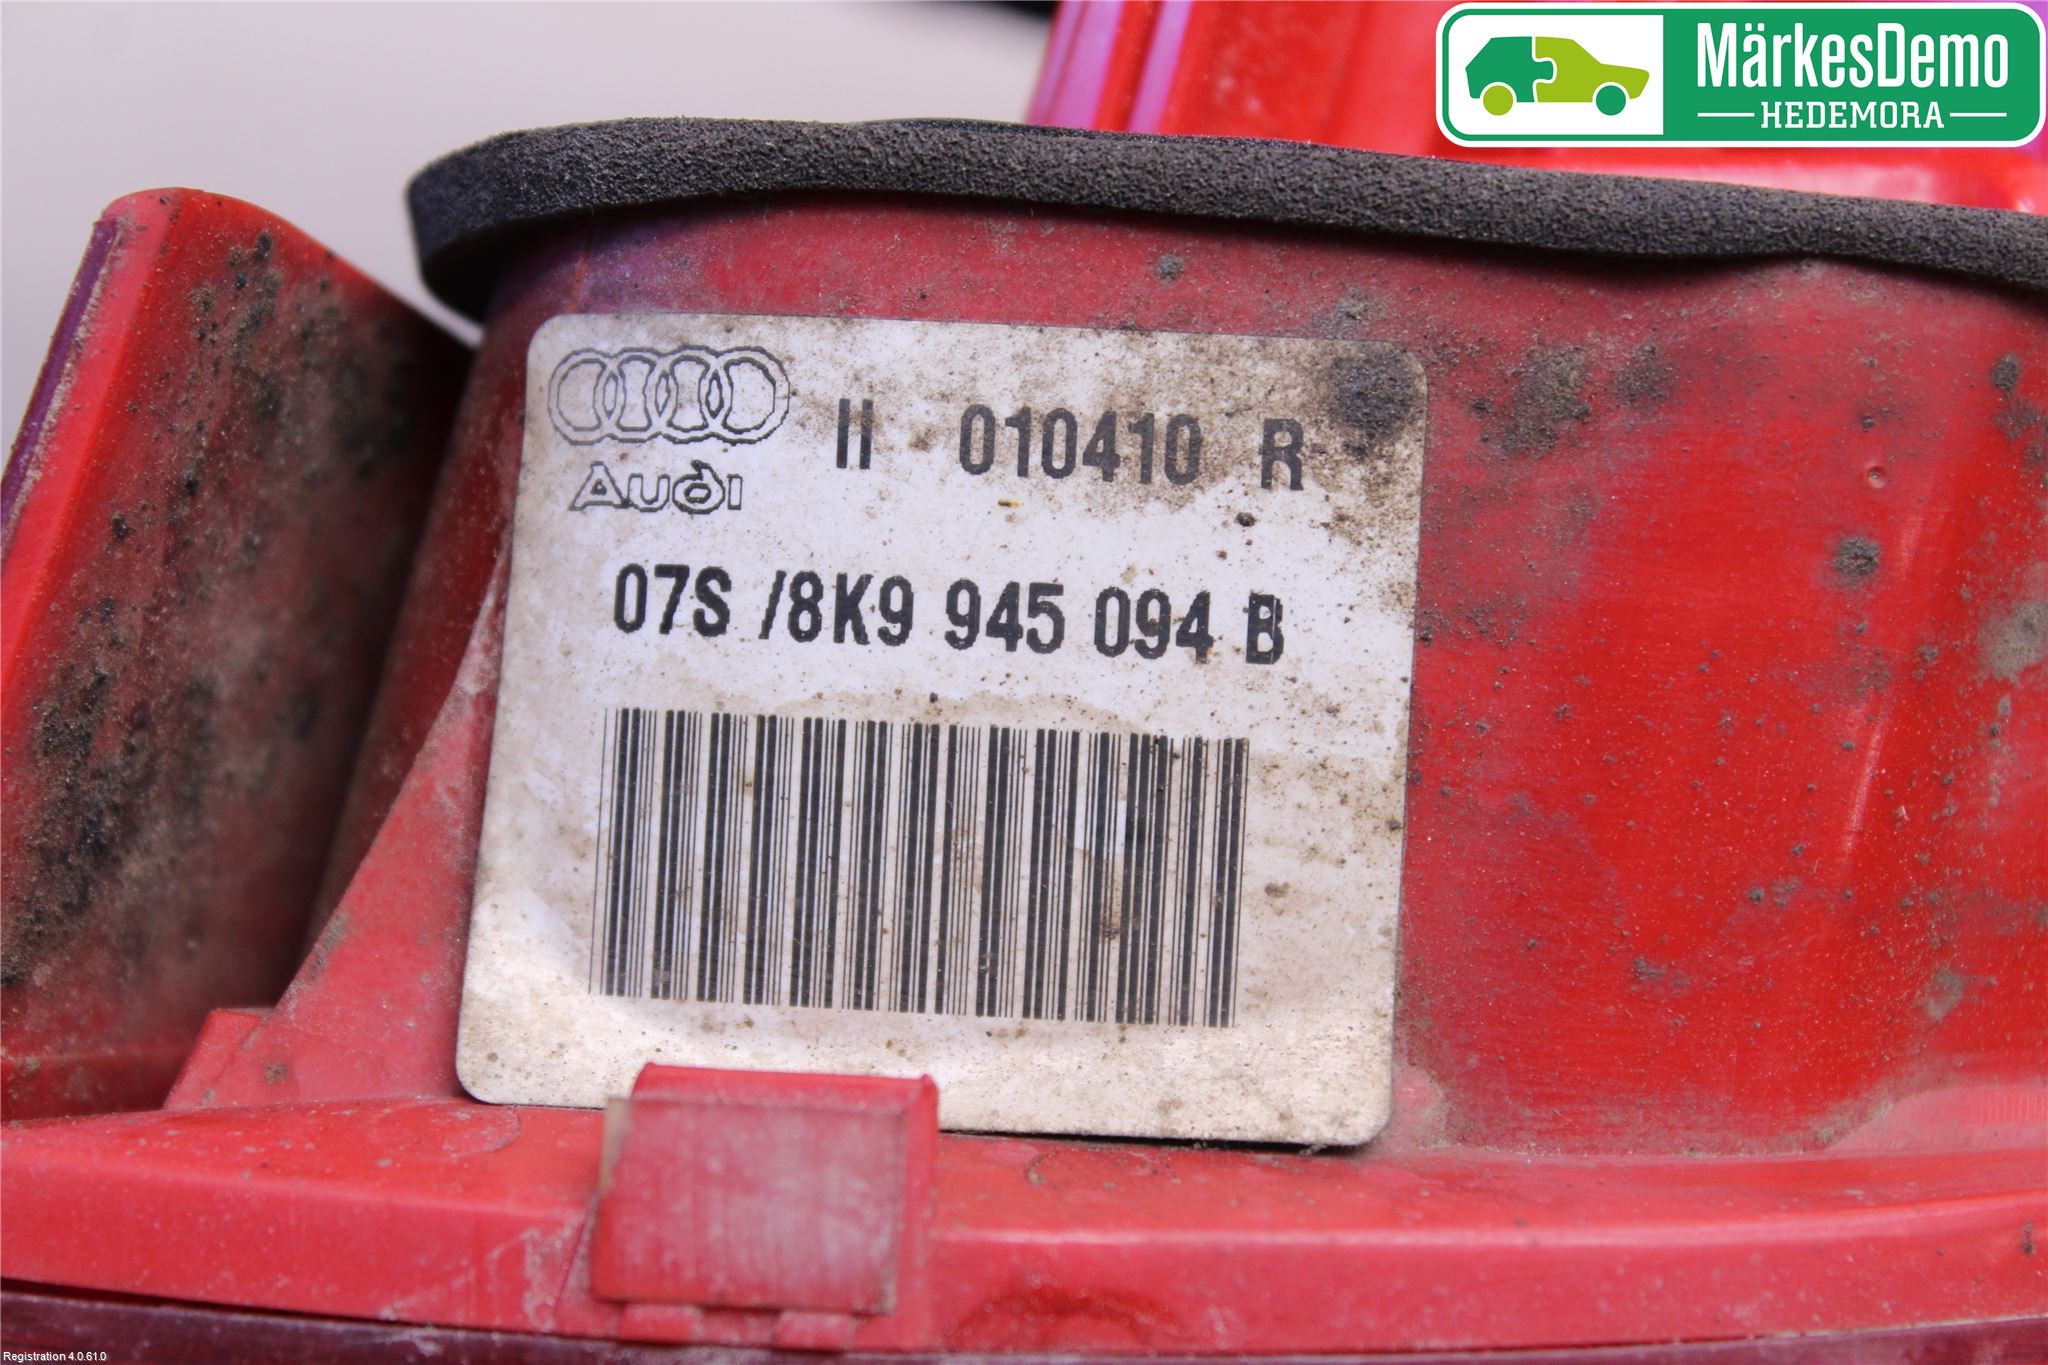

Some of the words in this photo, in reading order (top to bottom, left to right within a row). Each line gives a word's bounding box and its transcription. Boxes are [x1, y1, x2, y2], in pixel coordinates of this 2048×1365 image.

[568, 460, 743, 515] Audi
[954, 403, 1202, 486] 010410
[1261, 418, 1305, 491] R
[613, 563, 732, 638] 07S
[758, 570, 914, 646] /8K9
[944, 578, 1065, 654] 945
[1094, 586, 1214, 664] 094
[1245, 590, 1285, 665] B
